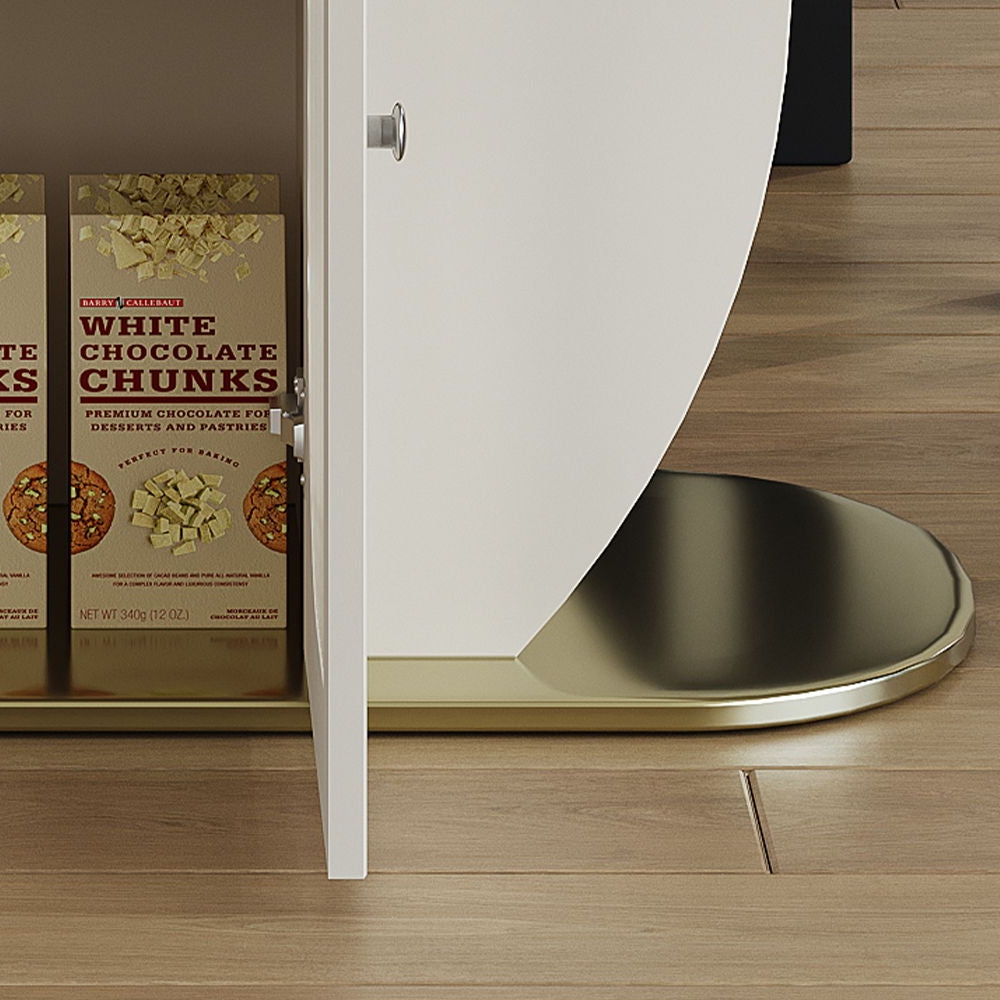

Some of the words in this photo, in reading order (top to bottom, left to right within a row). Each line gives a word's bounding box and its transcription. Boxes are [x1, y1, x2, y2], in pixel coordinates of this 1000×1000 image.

[81, 299, 115, 307] BARRY
[125, 299, 182, 307] CALLEBAUT
[79, 316, 216, 336] WHITE
[79, 344, 278, 361] CHOCOLATE
[79, 368, 279, 393] CHUNKS
[5, 409, 33, 419] FOR
[85, 409, 153, 419] PREMIUM
[156, 409, 241, 419] CHOCOLATE
[90, 423, 162, 432] DESSERTS
[165, 423, 196, 432] AND
[200, 423, 268, 432] PASTRIES
[118, 448, 166, 469] PERFECT
[198, 448, 240, 469] BAKING
[79, 608, 100, 620] NET
[101, 608, 118, 620] WT
[120, 608, 147, 622] 340g
[149, 608, 166, 622] (12
